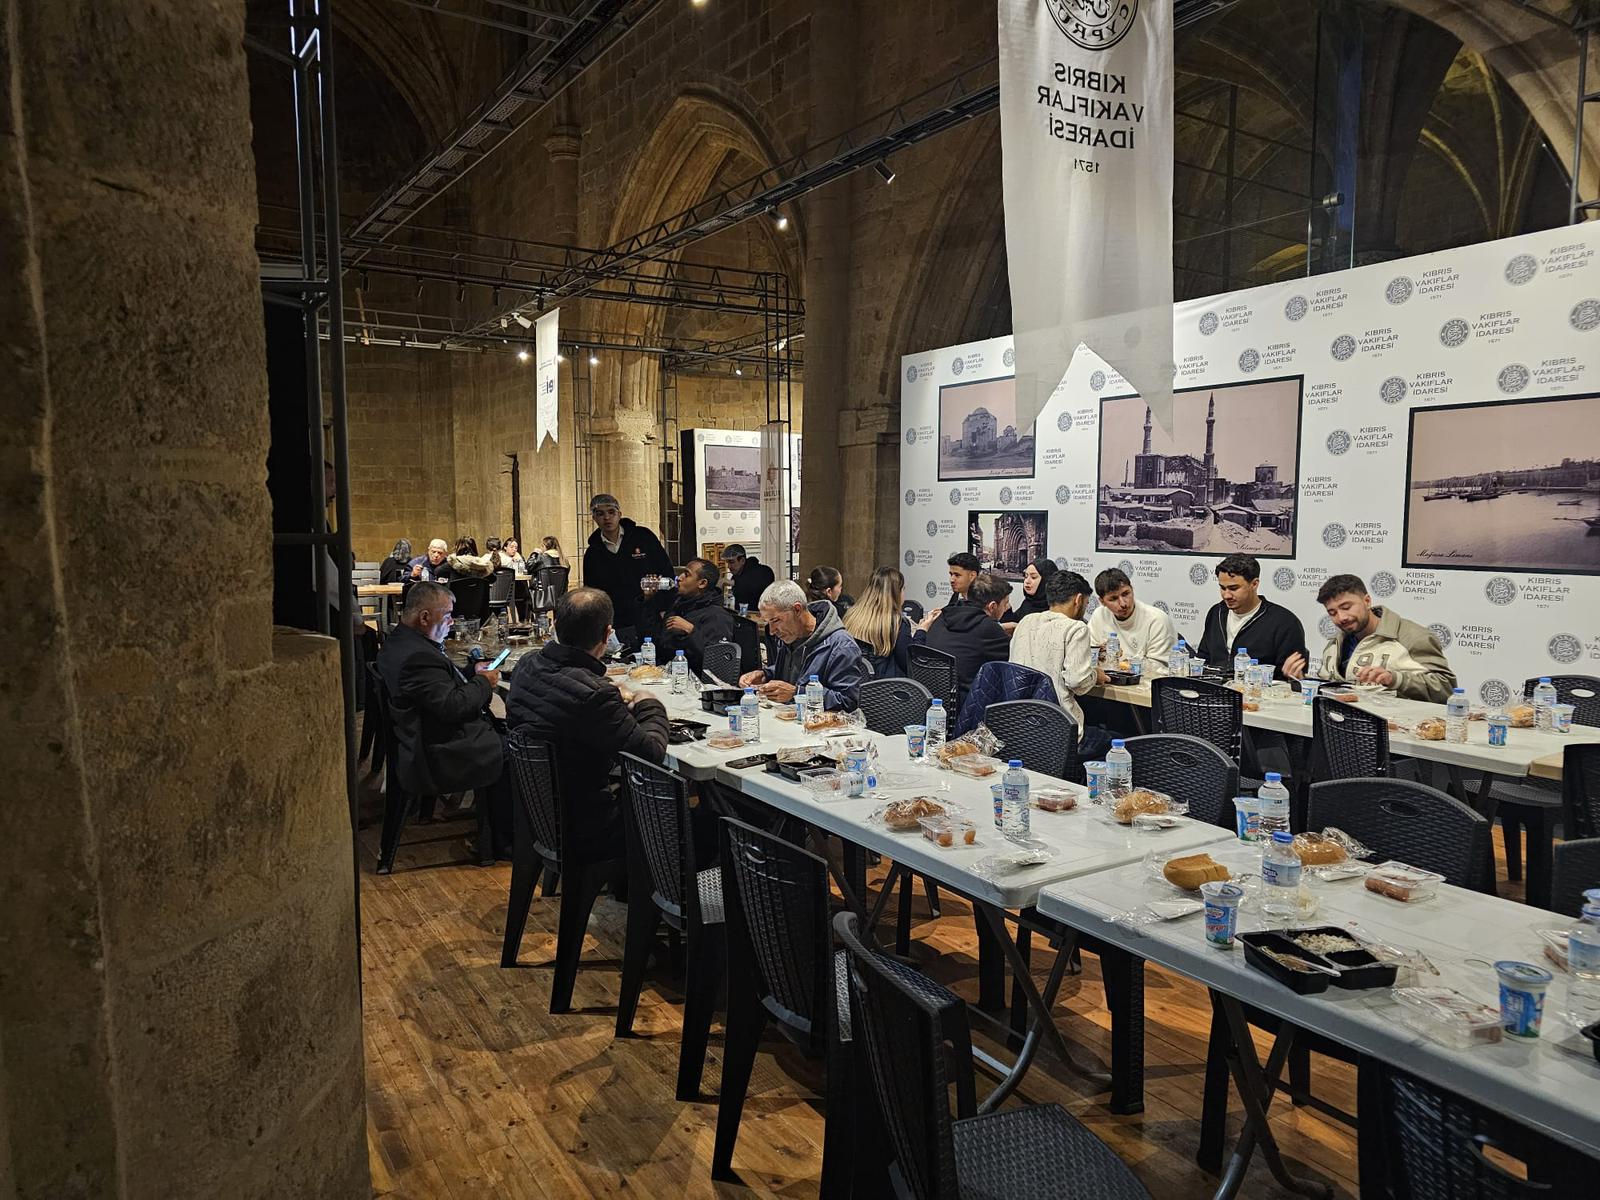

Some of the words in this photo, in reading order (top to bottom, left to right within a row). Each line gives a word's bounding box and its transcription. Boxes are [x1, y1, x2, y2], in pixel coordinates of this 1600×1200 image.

[1550, 243, 1585, 255] KIBRIS
[1541, 250, 1594, 265] VAKIFLAR
[1422, 267, 1452, 278] KIBRIS
[1415, 274, 1460, 287] VAKIFLAR
[1316, 287, 1342, 297] KIBRIS
[1310, 293, 1348, 305] VAKIFLAR
[1220, 311, 1252, 321] VAKIFLAR
[1480, 310, 1512, 320] KIBRIS
[1471, 317, 1520, 330] VAKIFLAR
[1365, 327, 1392, 337] KIBRIS
[1358, 334, 1399, 345] VAKIFLAR
[1261, 348, 1296, 359] VAKIFLAR
[1178, 361, 1209, 370] VAKIFLAR
[1541, 357, 1576, 367] KIBRIS
[1416, 371, 1446, 379] KIBRIS
[1532, 365, 1585, 376] VAKIFLAR
[1311, 382, 1336, 390] KIBRIS
[1409, 378, 1453, 388] VAKIFLAR
[1305, 389, 1343, 398] VAKIFLAR
[1360, 425, 1387, 433] KIBRIS
[1353, 433, 1393, 441] VAKIFLAR
[1406, 571, 1435, 579] KIBRIS
[1399, 579, 1442, 587] VAKIFLAR
[1528, 577, 1562, 585] KIBRIS
[1519, 585, 1570, 594] VAKIFLAR
[1462, 625, 1493, 633] KIBRIS
[1454, 632, 1501, 641] VAKIFLAR
